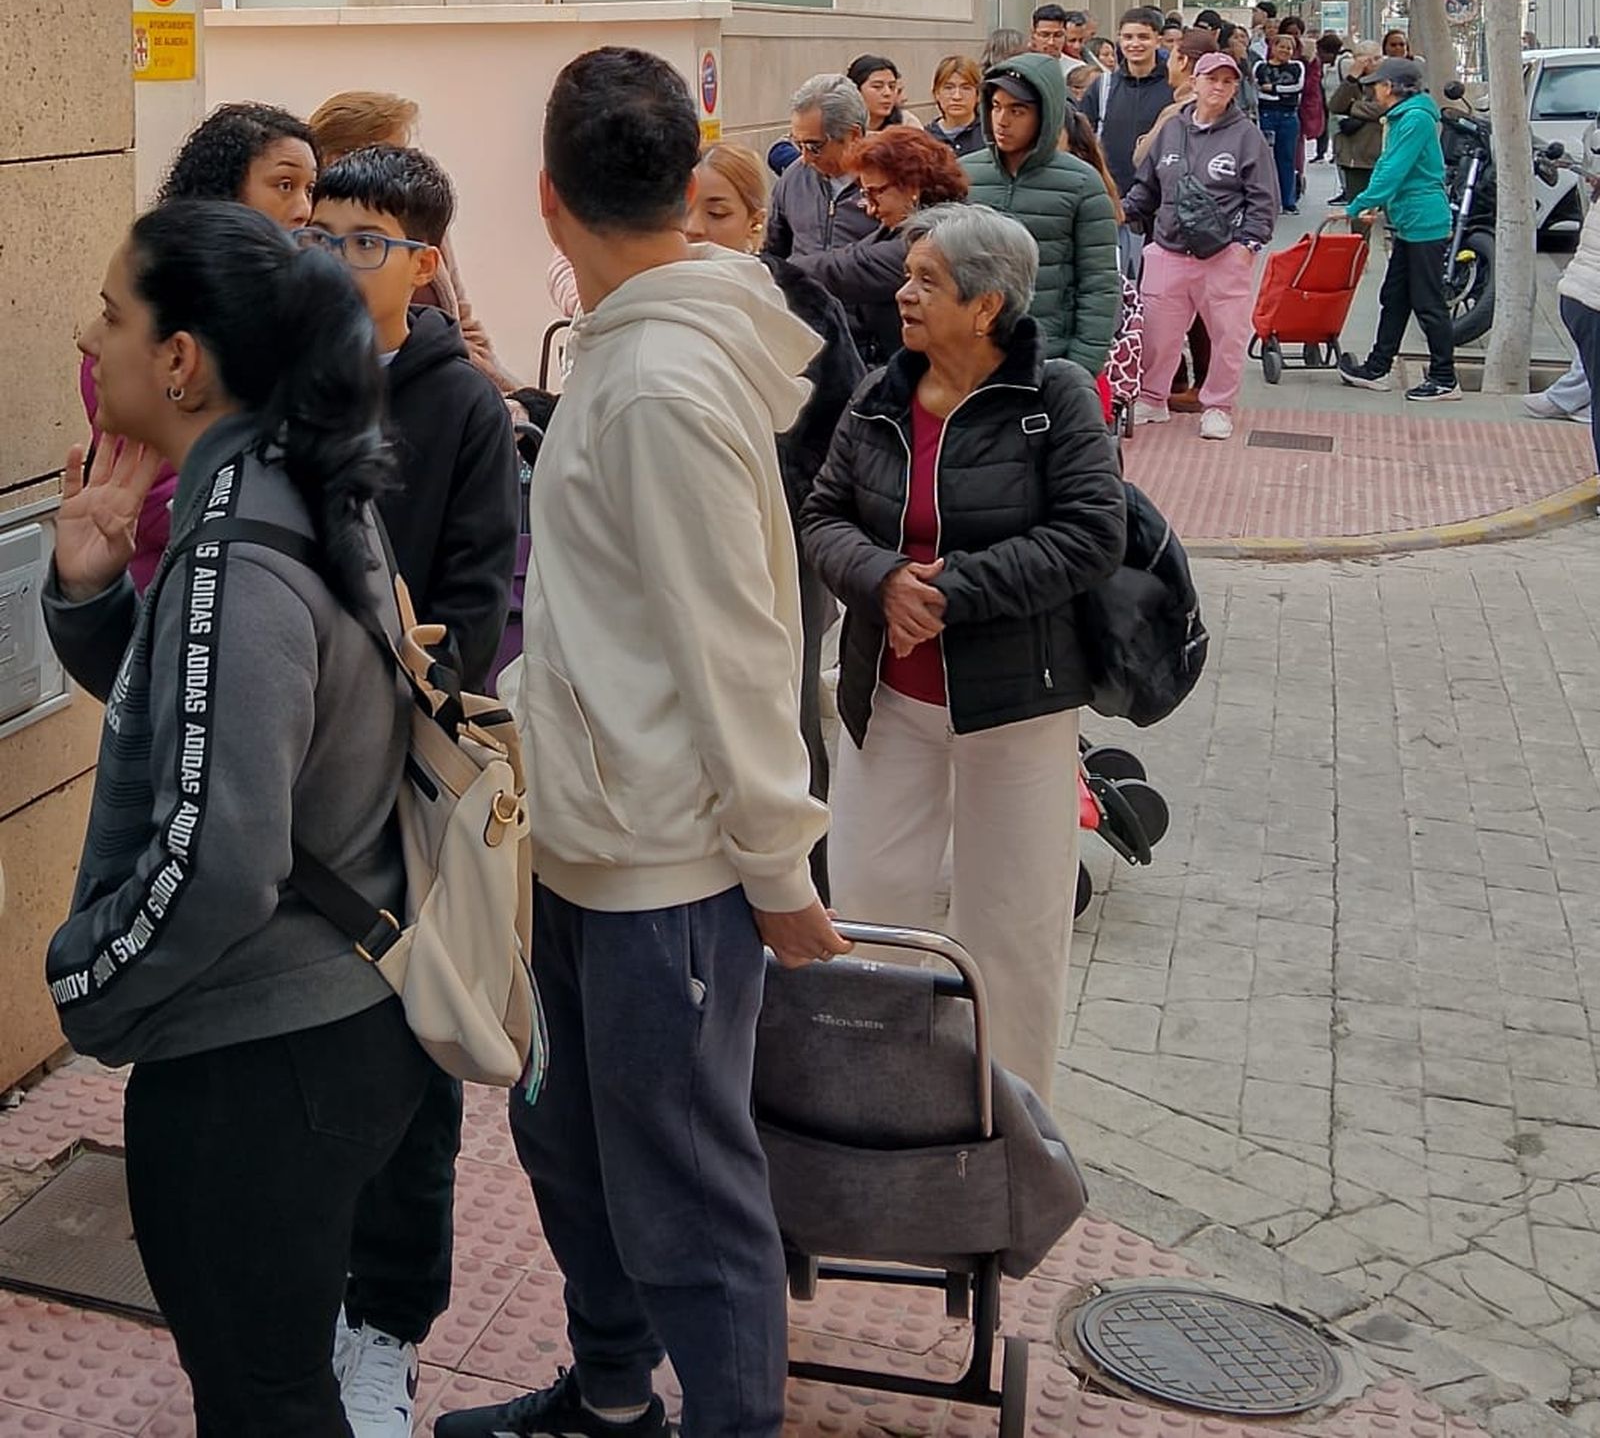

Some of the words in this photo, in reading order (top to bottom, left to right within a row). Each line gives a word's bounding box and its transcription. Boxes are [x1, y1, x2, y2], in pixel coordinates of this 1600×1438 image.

[189, 566, 218, 635] ADIDAS
[185, 642, 210, 714] ADIDAS
[180, 722, 206, 794] ADIDAS
[147, 859, 185, 919] ADIDS
[50, 970, 89, 1005] ADIDA
